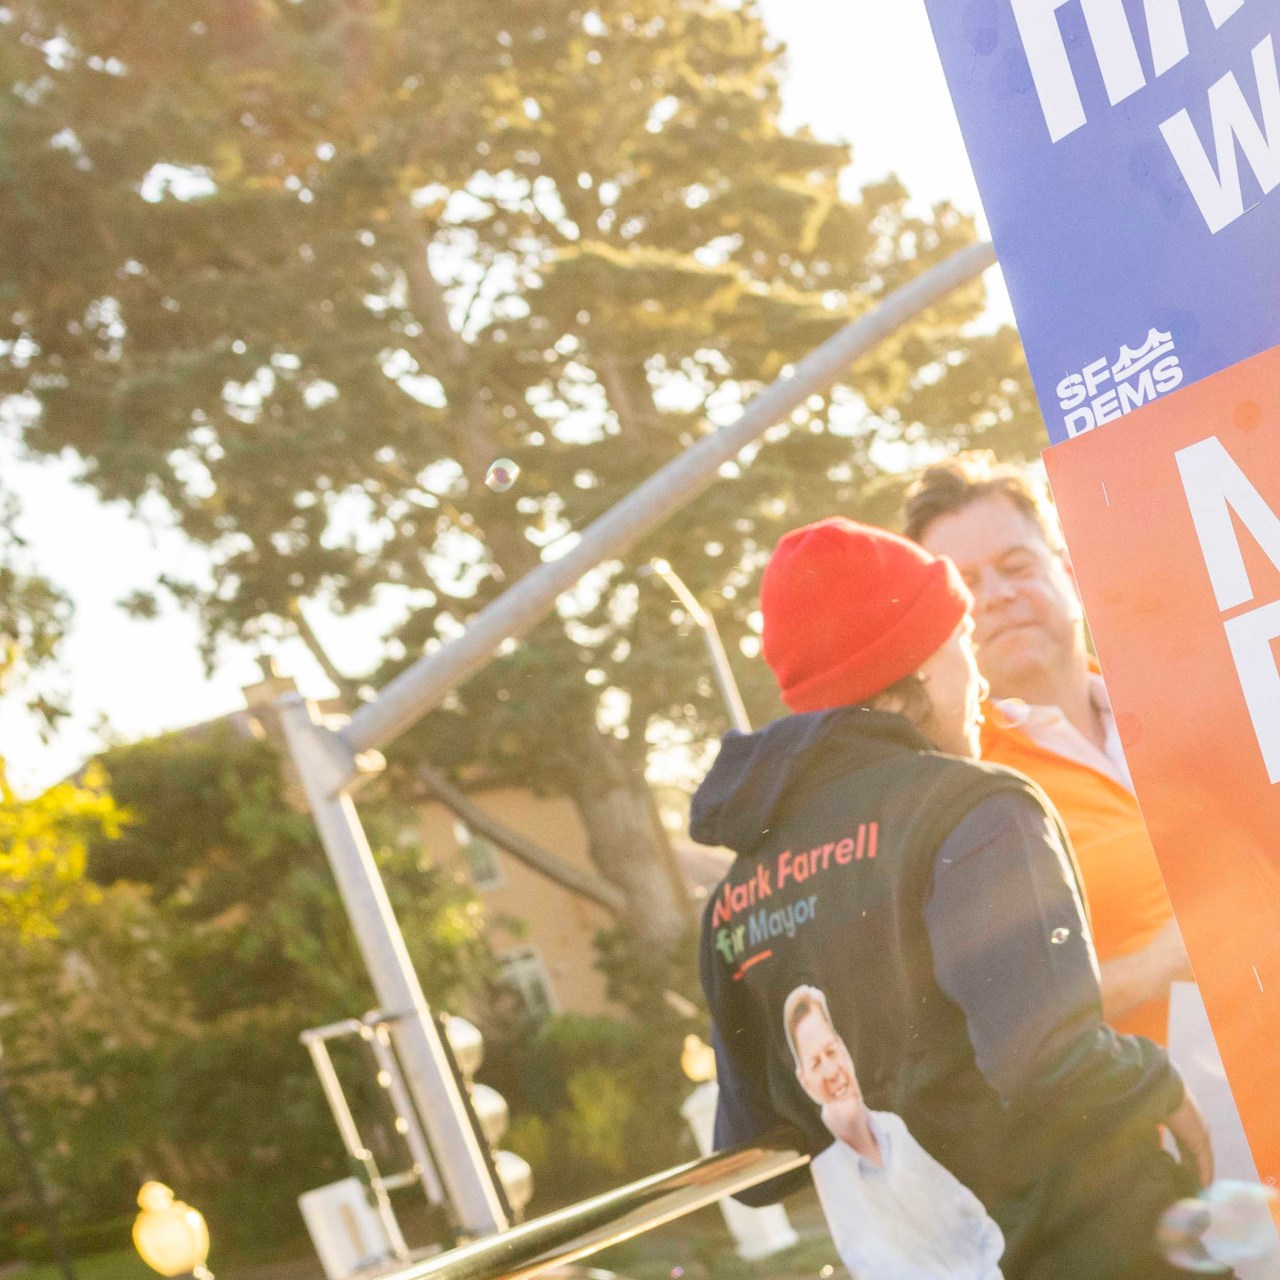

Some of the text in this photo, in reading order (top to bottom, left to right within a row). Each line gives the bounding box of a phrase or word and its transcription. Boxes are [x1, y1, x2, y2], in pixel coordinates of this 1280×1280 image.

[1056, 356, 1110, 410] SF
[1063, 355, 1184, 439] DEMS
[777, 822, 879, 890] Farrell
[748, 894, 817, 946] Mayor
